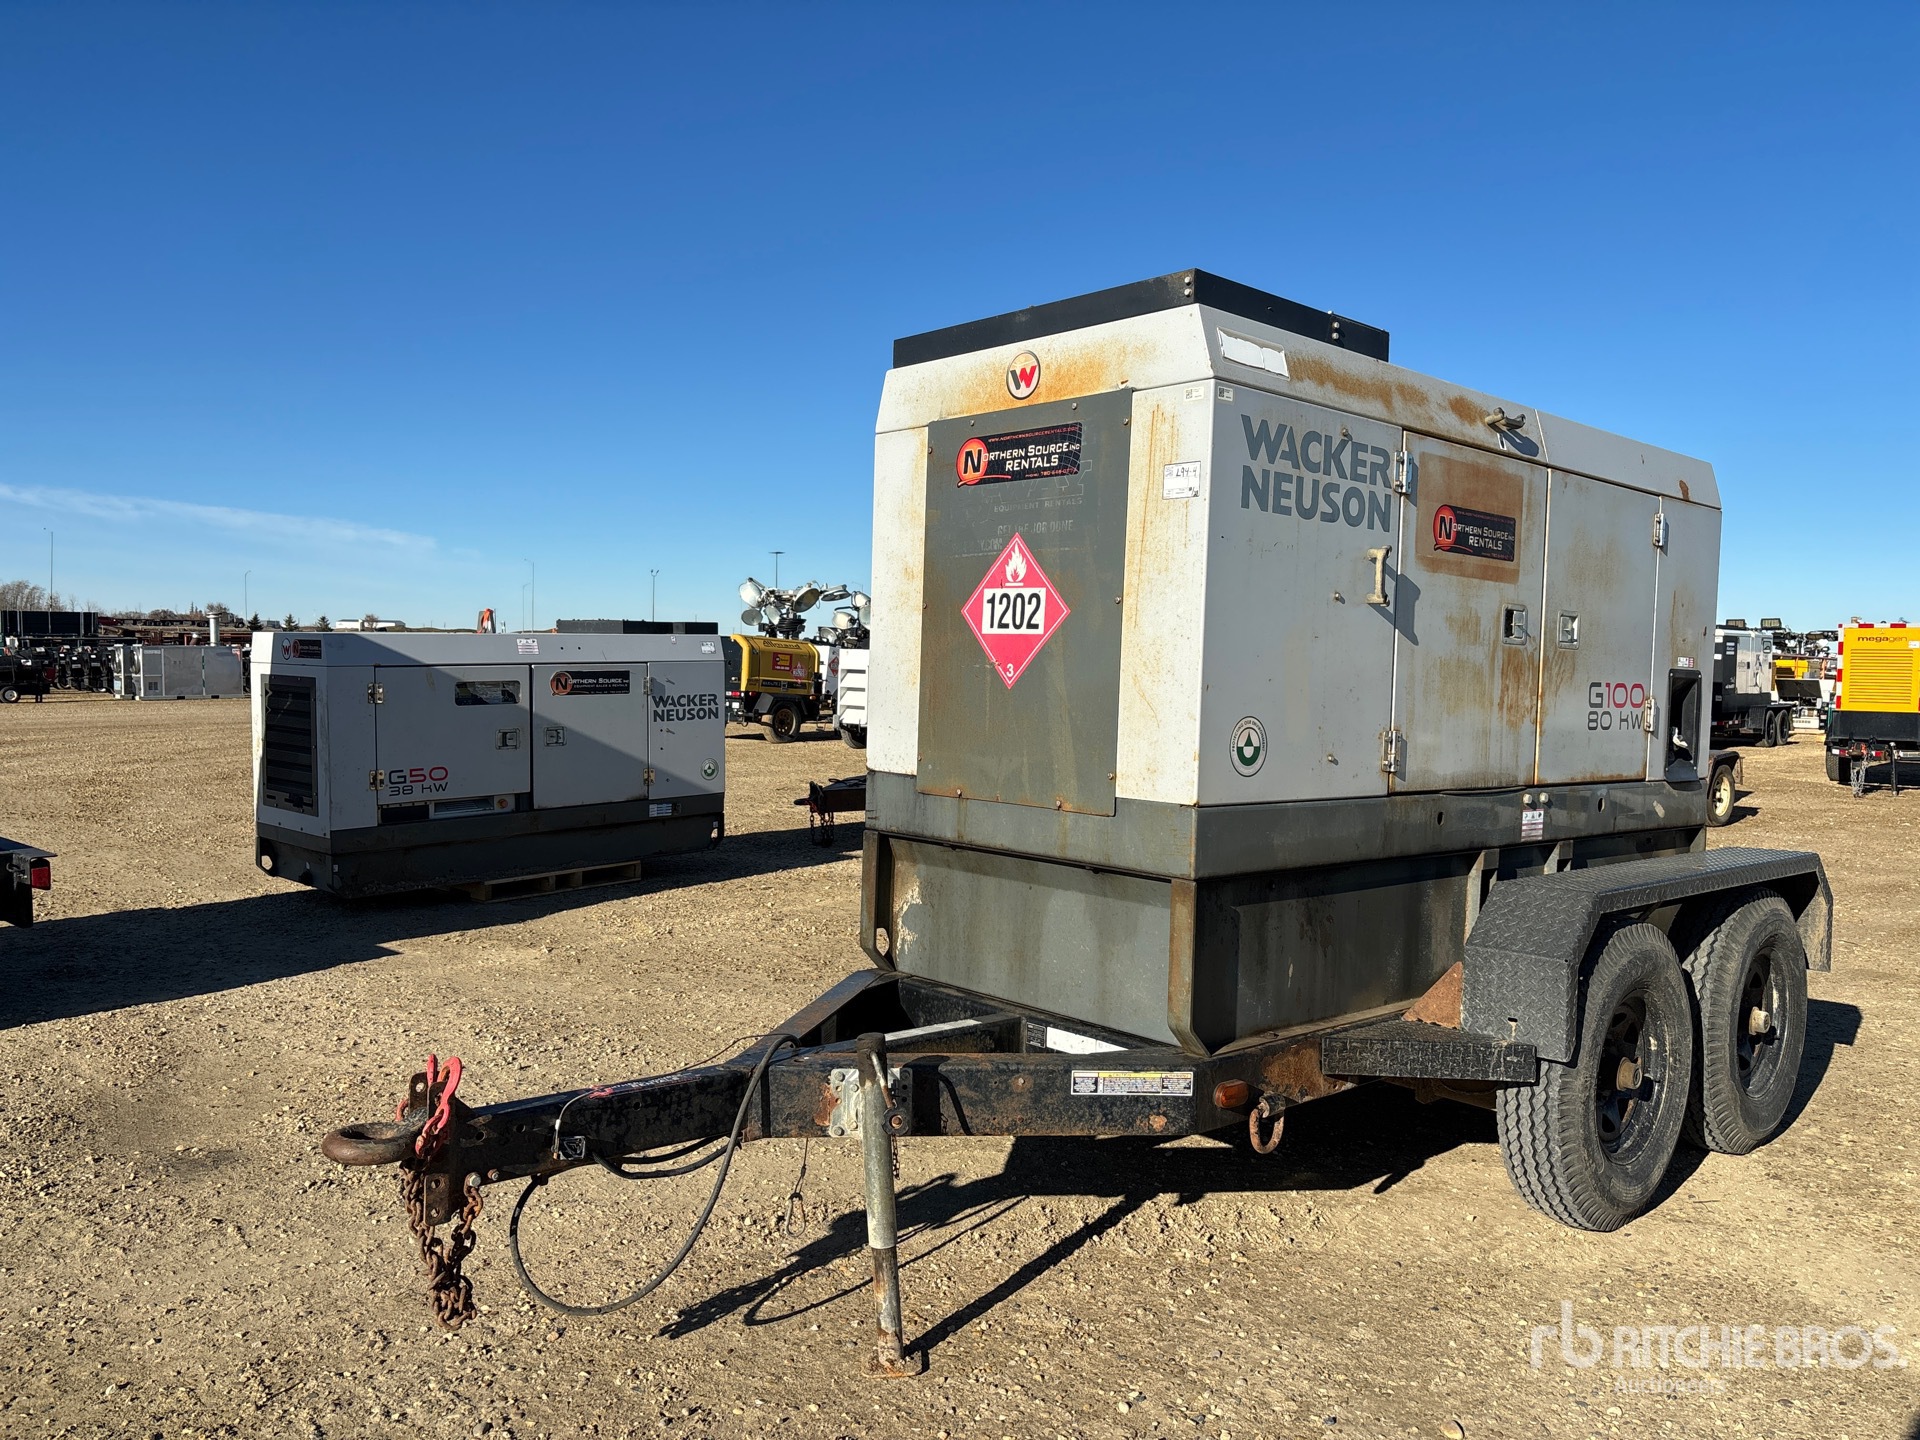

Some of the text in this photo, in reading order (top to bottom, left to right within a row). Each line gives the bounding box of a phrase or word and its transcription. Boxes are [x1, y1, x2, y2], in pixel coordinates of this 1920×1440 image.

[1010, 365, 1038, 391] W
[963, 447, 1026, 476] NORTHERN
[1027, 442, 1070, 457] SOURCE
[1241, 414, 1393, 489] WACKER
[1005, 454, 1060, 472] RENTALS
[1241, 465, 1392, 533] NEUSON
[1437, 514, 1482, 542] NORTHERN
[1483, 527, 1509, 541] SOURCE
[1468, 535, 1503, 551] RENTALS
[986, 592, 1042, 630] 1202
[1006, 663, 1015, 678] 3
[651, 693, 719, 709] WACKER
[1588, 682, 1645, 709] G100
[653, 707, 719, 722] NEUSON
[1587, 711, 1613, 731] 80
[389, 766, 449, 785] G50
[389, 785, 414, 797] 38
